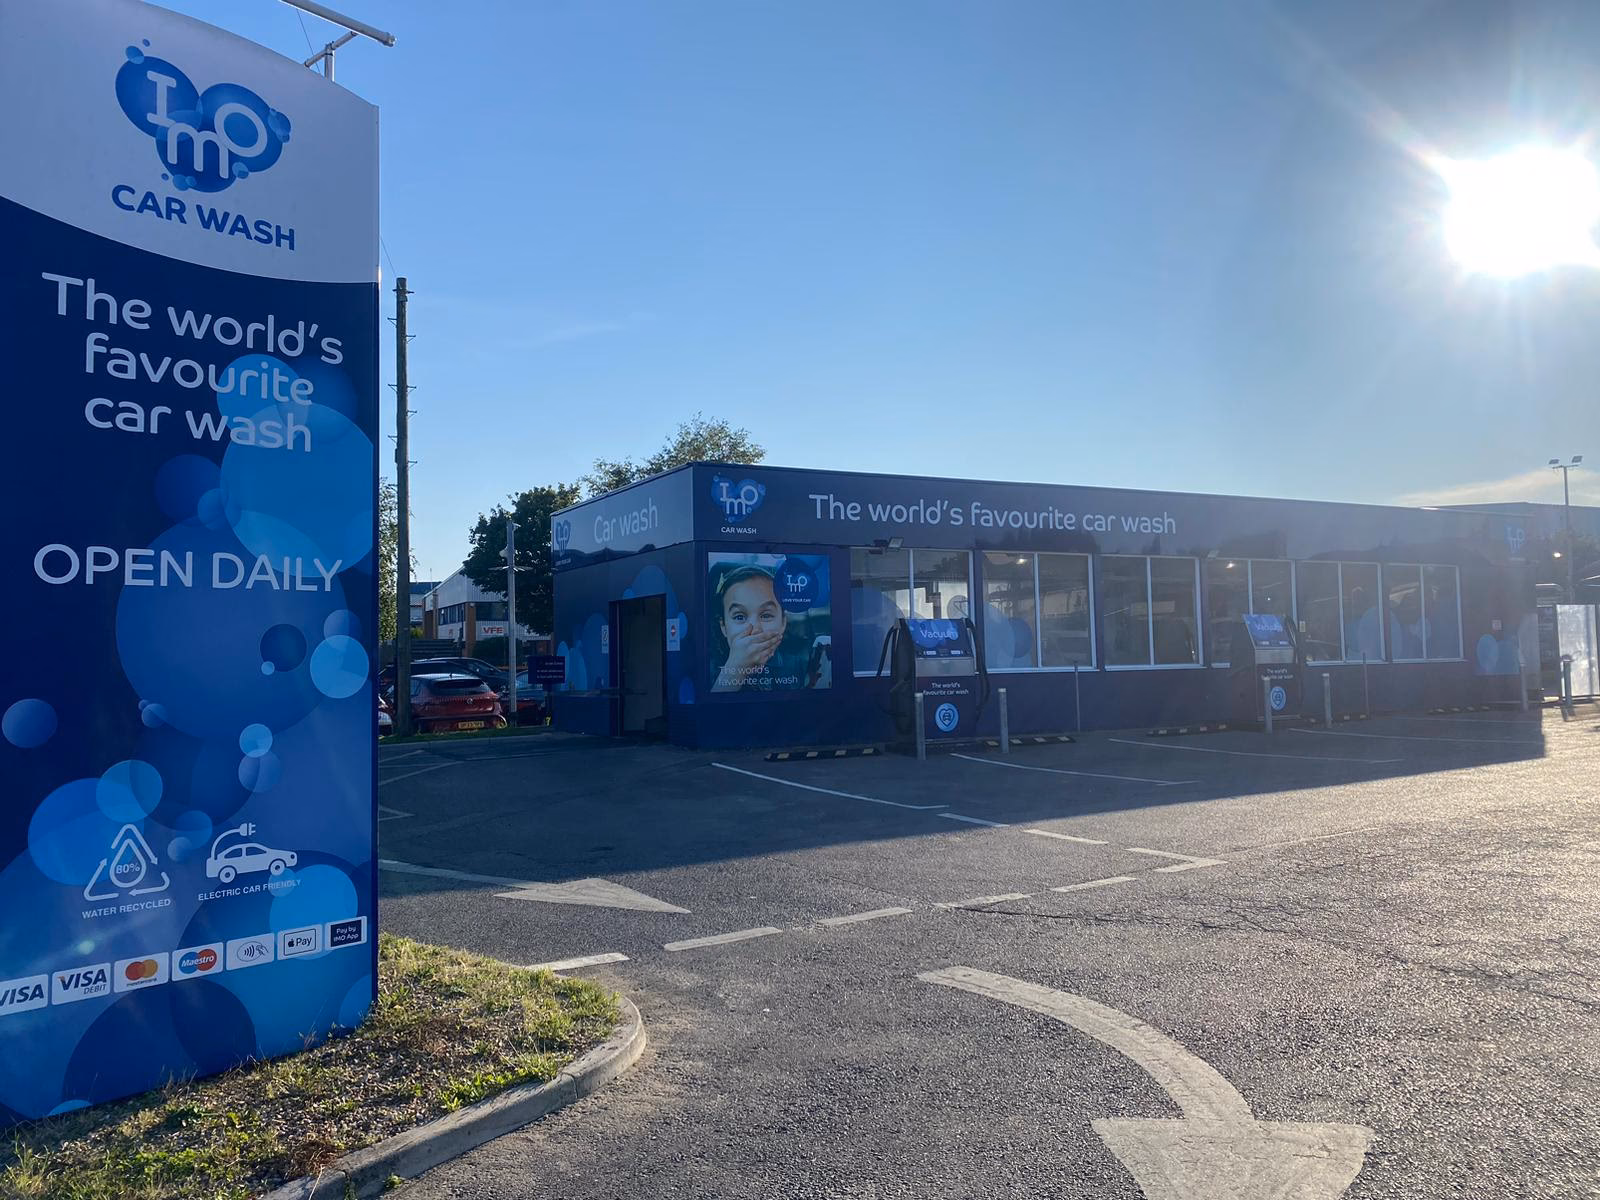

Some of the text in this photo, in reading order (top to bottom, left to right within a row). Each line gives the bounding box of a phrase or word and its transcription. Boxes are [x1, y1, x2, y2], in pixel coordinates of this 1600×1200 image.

[112, 184, 295, 250] CAR WASH
[42, 271, 343, 364] The world's
[85, 333, 314, 406] favourite
[85, 397, 312, 452] car wash
[594, 497, 658, 544] Car wash
[808, 494, 1176, 534] The world's favourite car wash
[34, 543, 343, 592] OPEN DAILY
[920, 629, 958, 639] Vacuum
[718, 664, 770, 674] The world's
[718, 675, 798, 686] favourite car wash
[115, 862, 141, 875] 80%
[198, 879, 301, 901] ELECTRIC CAR FRIENDLY
[82, 898, 172, 919] WATER RECYCLED
[336, 925, 357, 935] Pay by
[347, 933, 359, 942] App
[296, 936, 313, 947] Pay
[180, 955, 215, 968] Maestro
[58, 969, 107, 991] VISA
[83, 984, 107, 995] DEBIT
